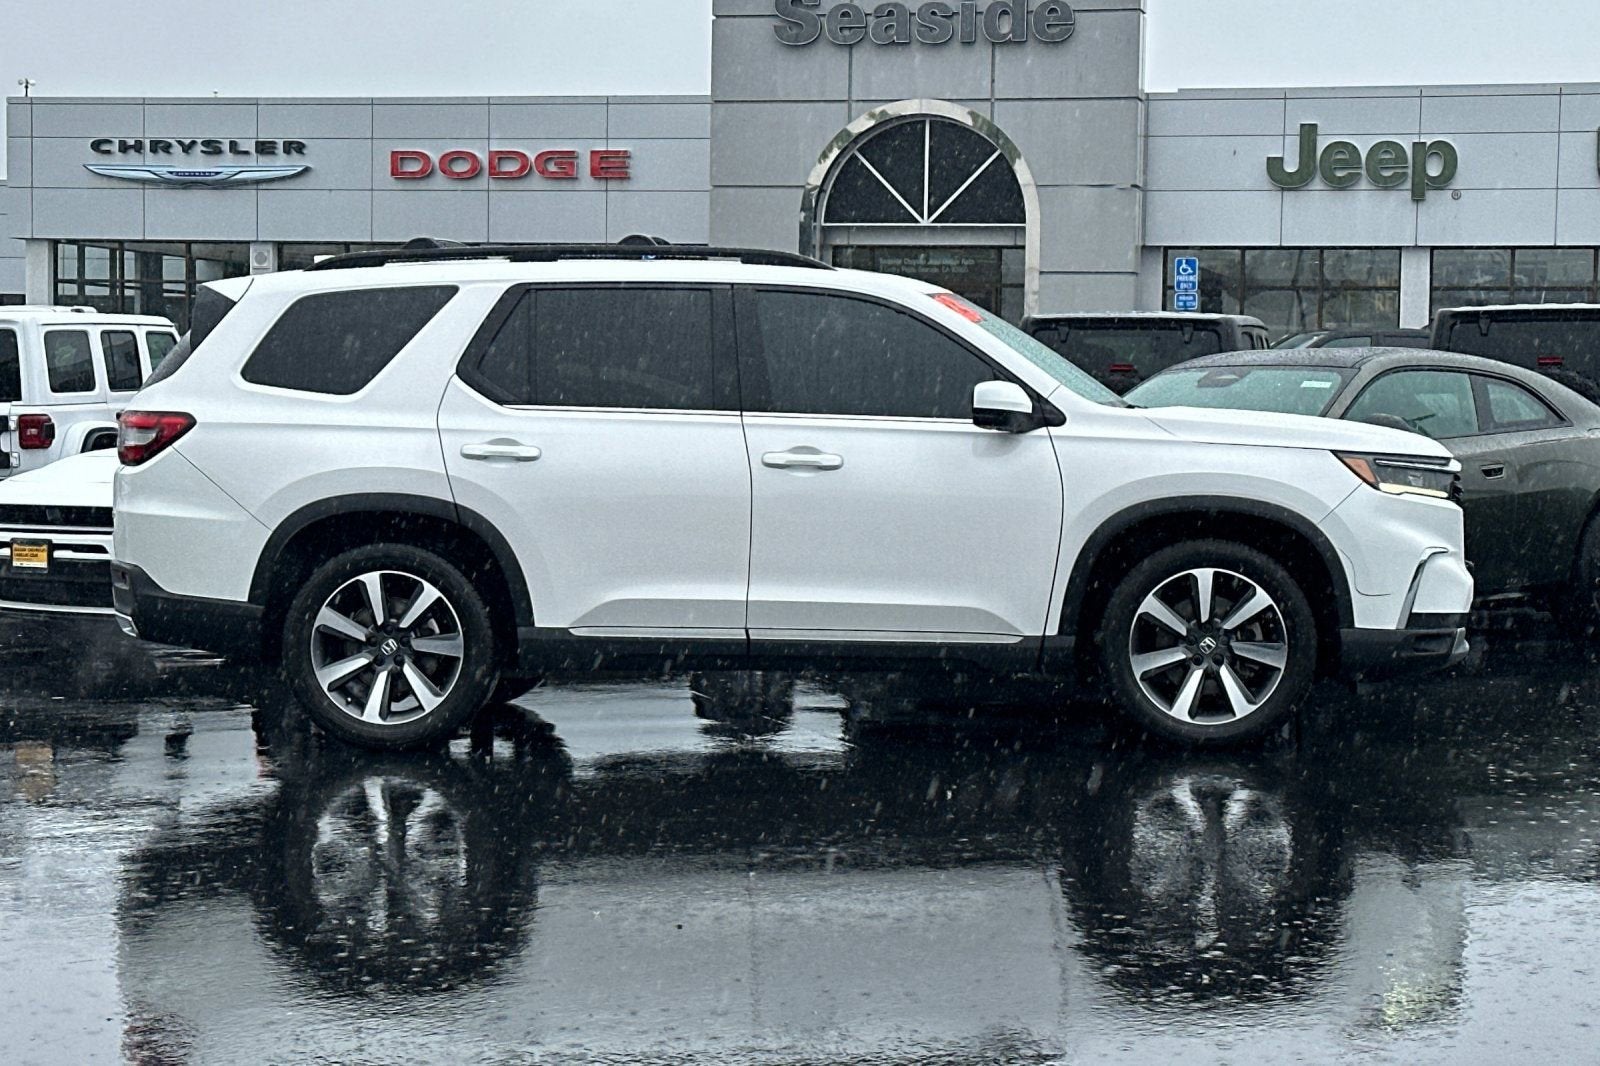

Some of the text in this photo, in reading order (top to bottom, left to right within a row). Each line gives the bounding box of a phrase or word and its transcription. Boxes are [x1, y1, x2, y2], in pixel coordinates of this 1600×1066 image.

[773, 0, 1076, 46] Seaside
[90, 138, 307, 155] CHRYSLER
[390, 149, 632, 180] DODGE
[1266, 123, 1459, 201] Jeep
